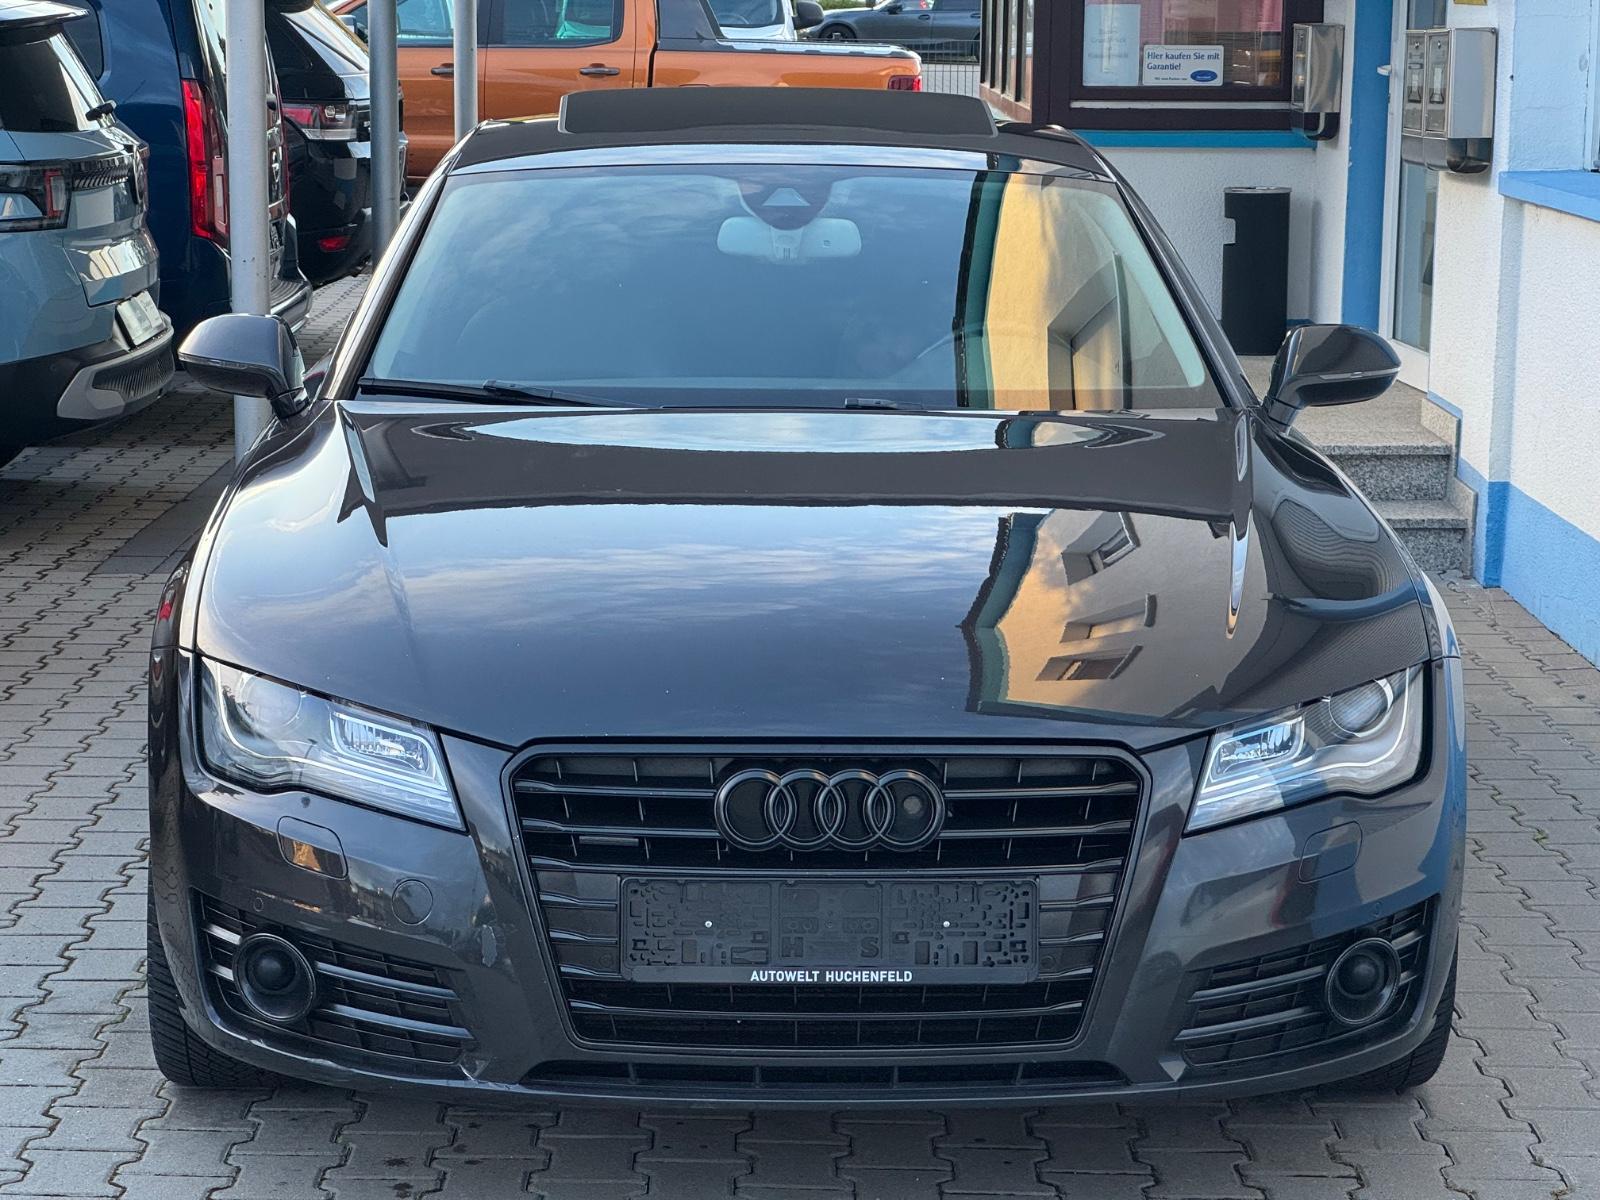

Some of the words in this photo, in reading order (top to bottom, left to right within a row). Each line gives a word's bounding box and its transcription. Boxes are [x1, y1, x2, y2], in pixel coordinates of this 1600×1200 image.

[1147, 51, 1163, 60] Hier
[1165, 51, 1191, 60] kaufen
[1193, 51, 1205, 60] Sie
[1207, 51, 1220, 60] mit
[750, 970, 820, 982] AUTOWELT
[825, 970, 913, 982] HUCHENFELD
